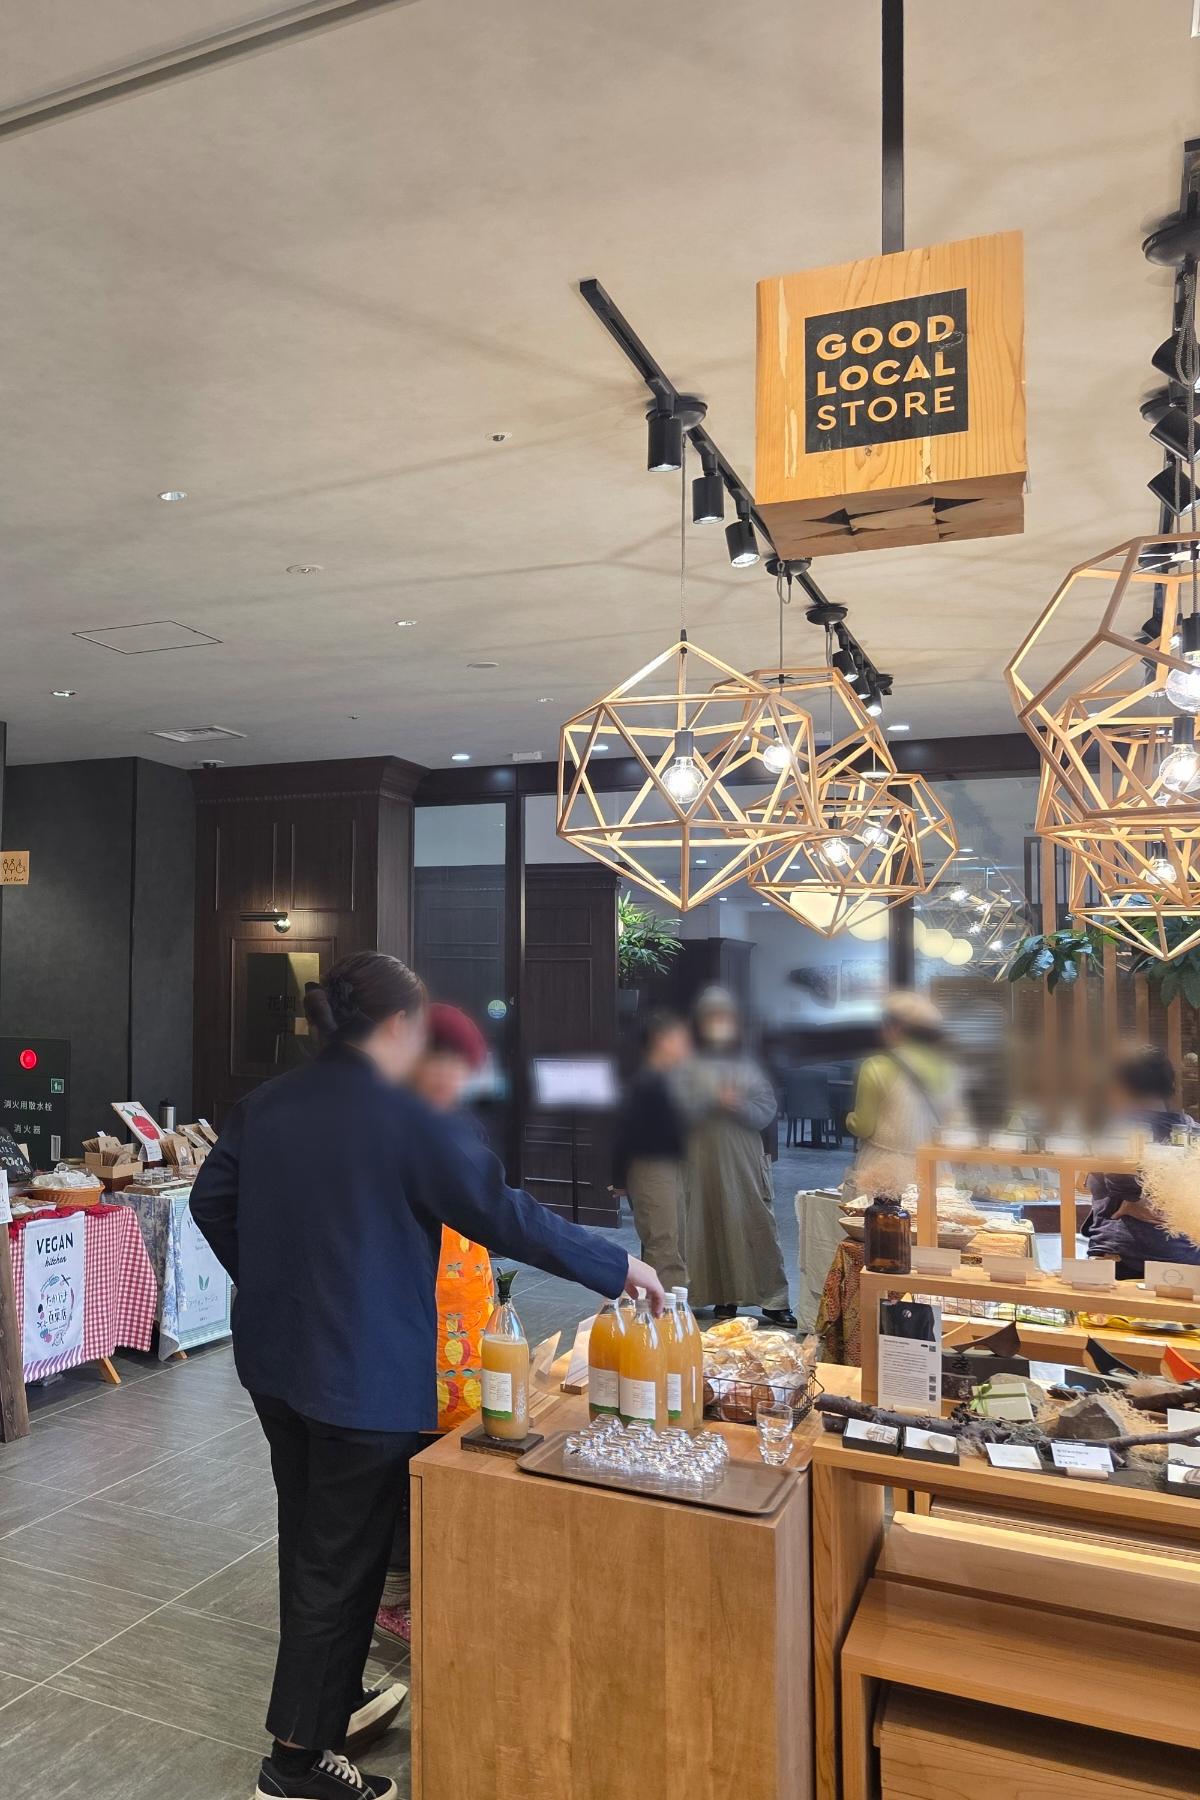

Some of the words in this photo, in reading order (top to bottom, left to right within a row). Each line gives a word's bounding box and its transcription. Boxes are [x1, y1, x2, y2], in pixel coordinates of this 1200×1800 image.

[816, 315, 955, 360] GOOD
[816, 351, 955, 396] LOCAL
[816, 386, 955, 430] STORE
[3, 1099, 52, 1111] 消火用散水栓
[14, 1124, 40, 1134] 消火器
[36, 1232, 74, 1255] VEGAN
